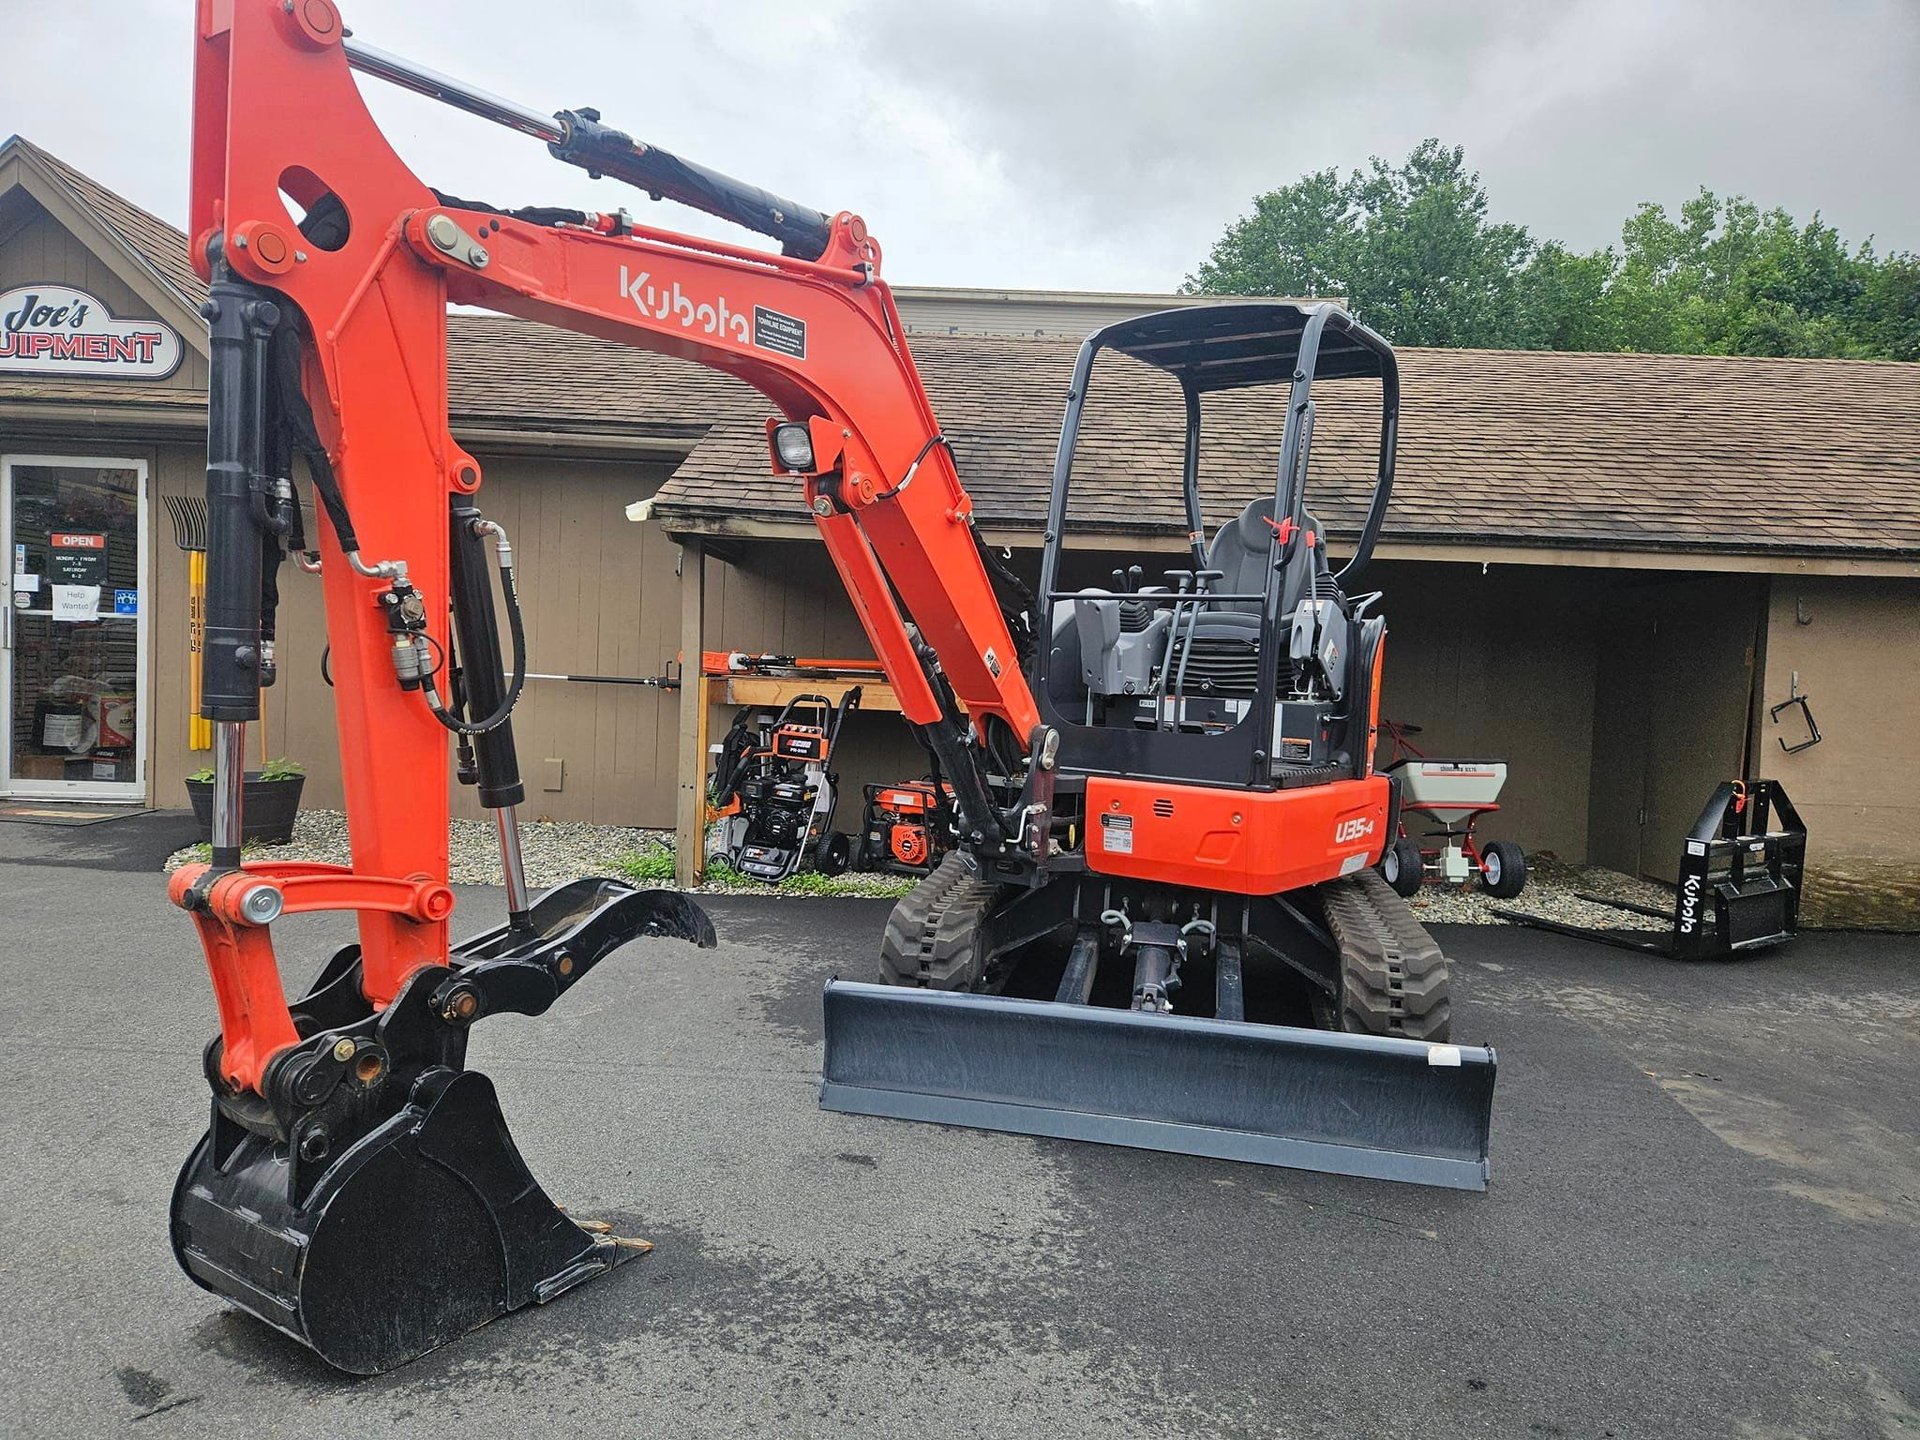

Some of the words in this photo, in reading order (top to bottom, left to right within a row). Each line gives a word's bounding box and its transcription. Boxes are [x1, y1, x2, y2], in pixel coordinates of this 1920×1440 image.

[5, 295, 89, 331] Joe's
[620, 265, 749, 344] Kubota
[62, 536, 94, 546] OPEN
[61, 602, 89, 610] Wanted
[67, 591, 86, 599] Help
[1335, 817, 1374, 844] U35-4
[1681, 875, 1701, 933] Kubota
